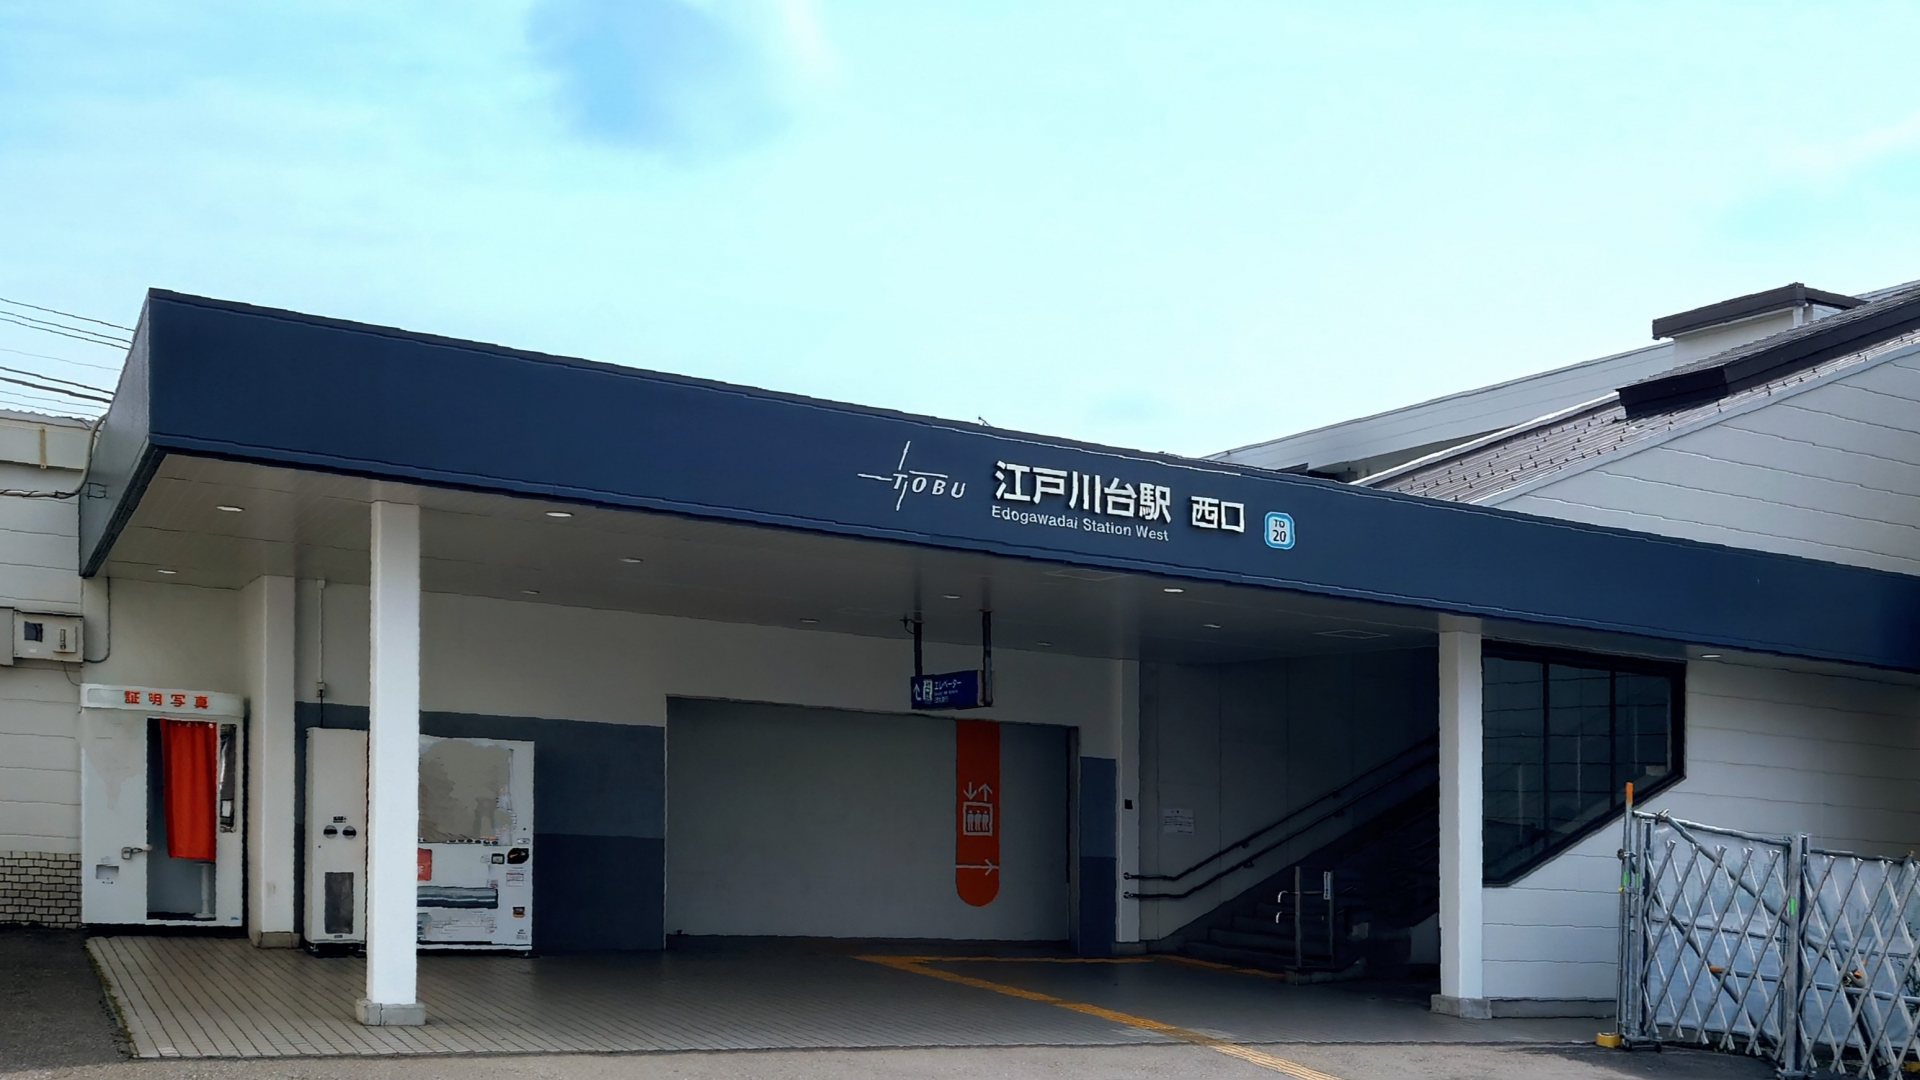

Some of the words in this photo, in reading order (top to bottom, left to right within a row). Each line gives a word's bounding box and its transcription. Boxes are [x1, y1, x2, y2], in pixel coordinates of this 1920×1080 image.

[893, 473, 966, 498] TOBU
[995, 460, 1171, 523] 江戸川台駅
[1191, 496, 1245, 533] 西口
[991, 505, 1078, 529] Edogawadai
[1082, 518, 1131, 536] Station
[1135, 525, 1169, 541] West
[1273, 519, 1285, 528] TO
[1272, 529, 1286, 542] 20
[934, 678, 962, 690] エレベーター
[124, 690, 209, 709] 証明写真
